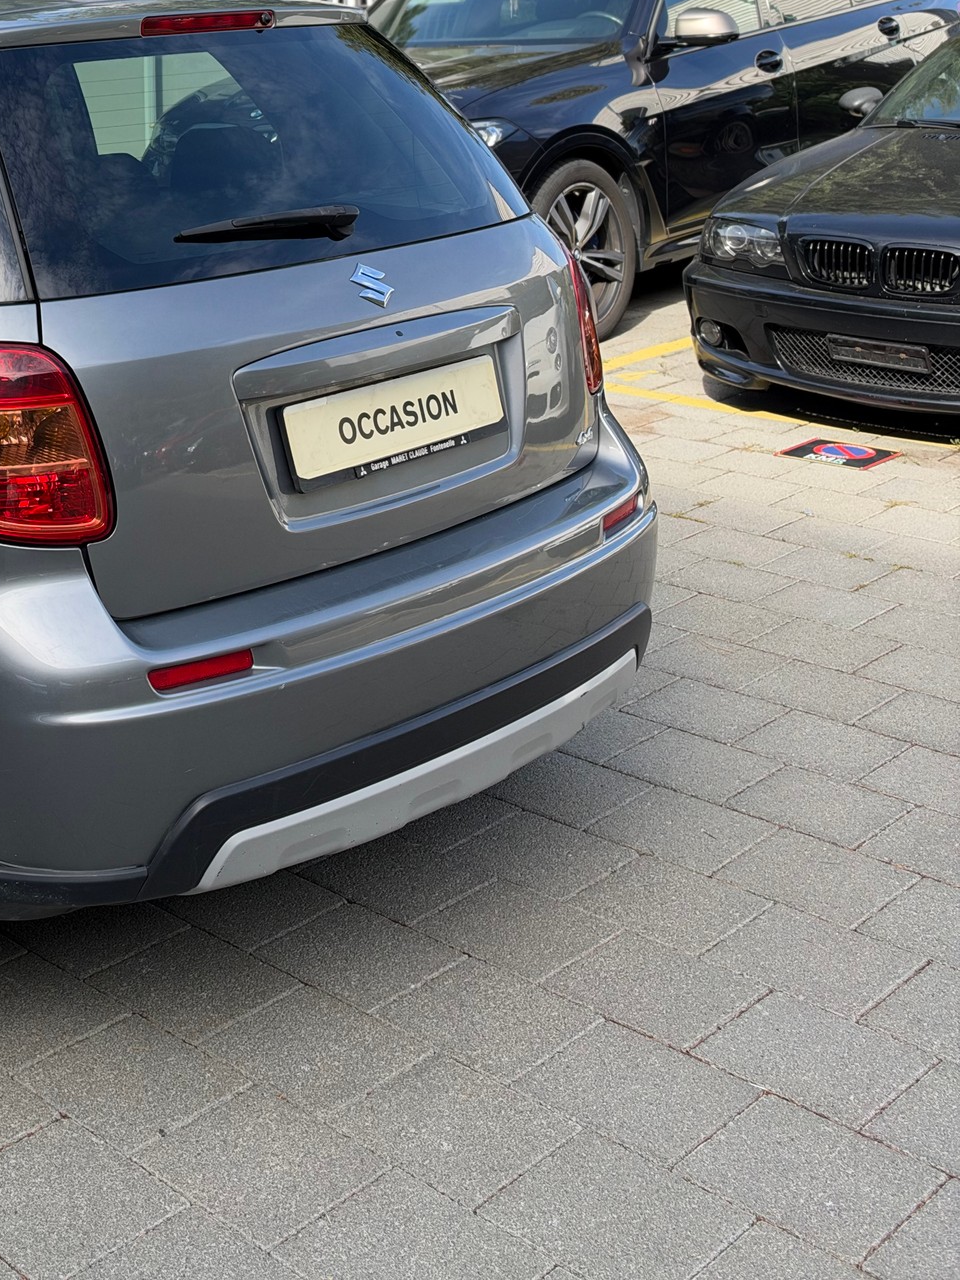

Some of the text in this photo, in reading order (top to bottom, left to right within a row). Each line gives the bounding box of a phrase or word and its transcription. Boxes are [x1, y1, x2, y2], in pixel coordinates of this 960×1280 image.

[338, 389, 458, 445] OCCASION
[370, 439, 456, 471] Garage MARET CLAUDE Fontenelle
